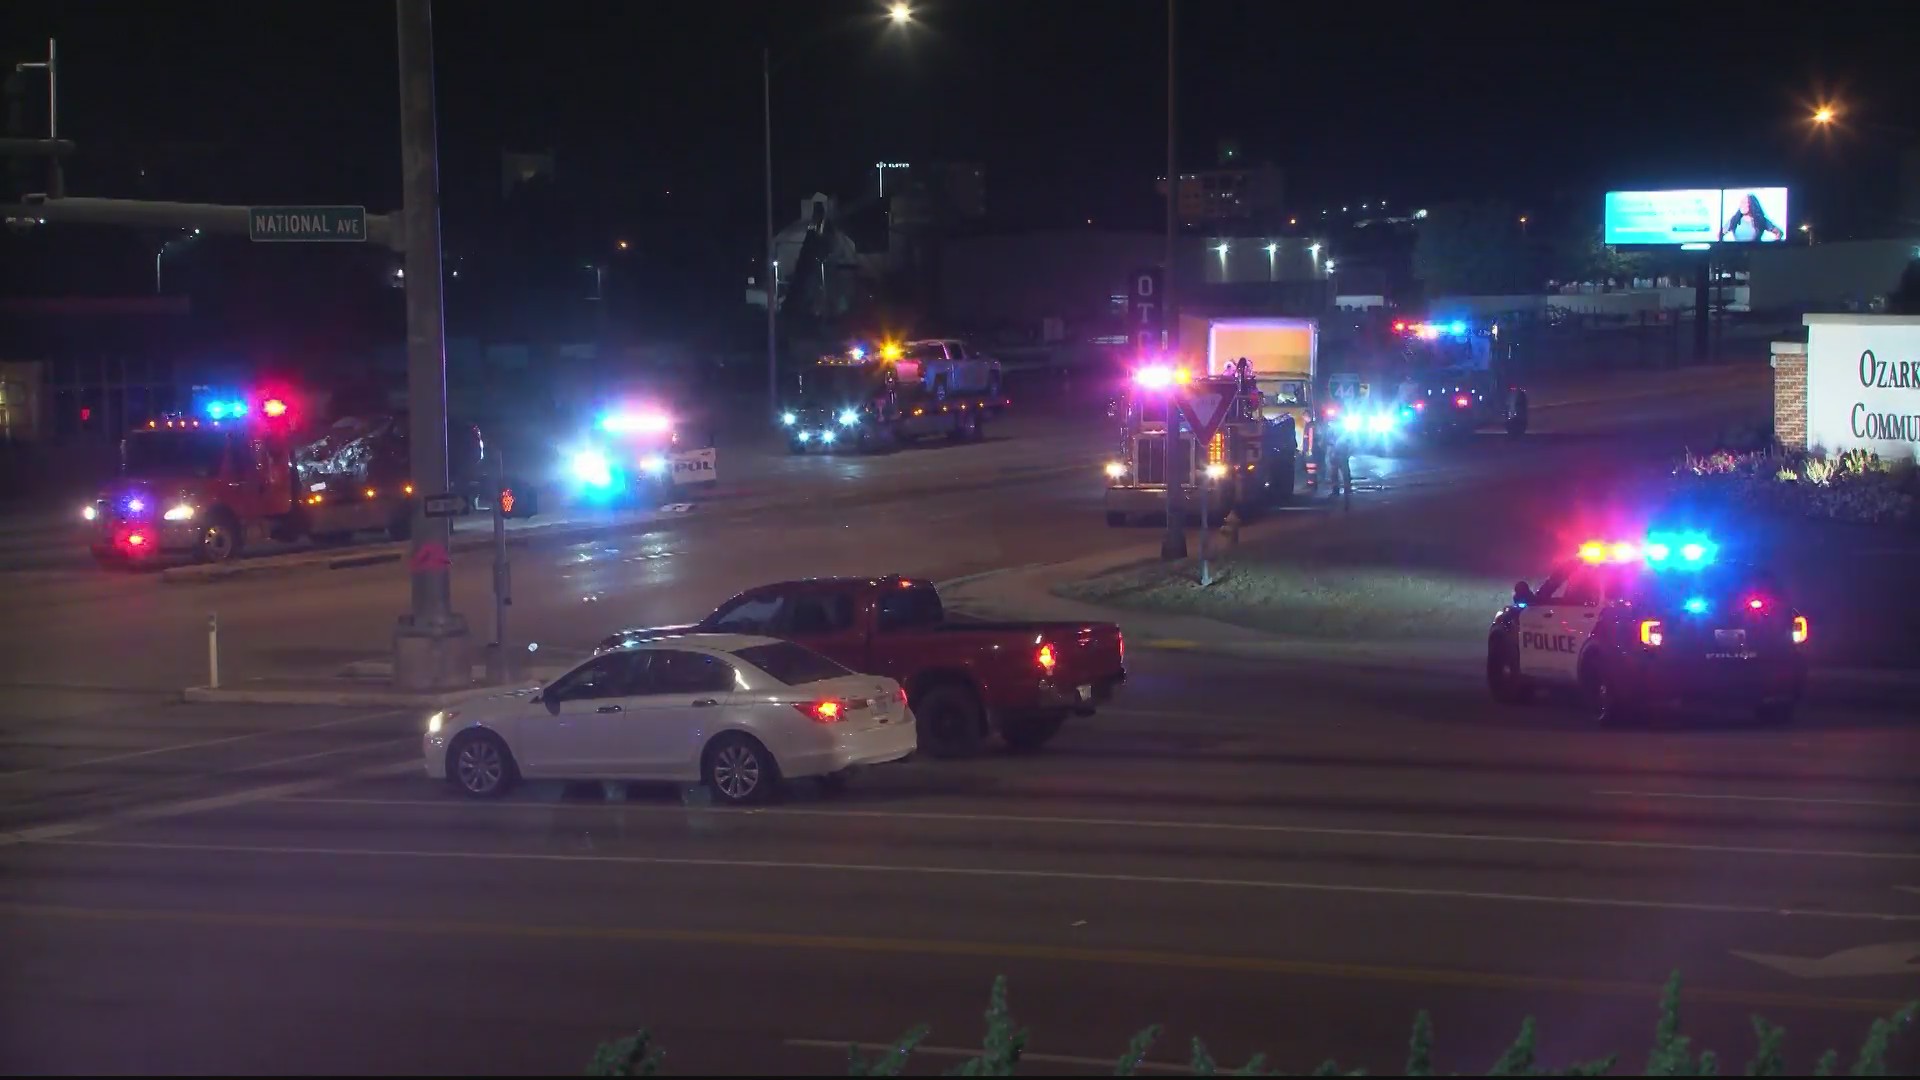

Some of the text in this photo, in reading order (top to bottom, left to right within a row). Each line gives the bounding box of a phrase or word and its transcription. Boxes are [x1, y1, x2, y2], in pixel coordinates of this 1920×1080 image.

[255, 215, 359, 234] NATIONAL AVE
[1334, 384, 1355, 400] 44
[1522, 631, 1577, 654] POLICE
